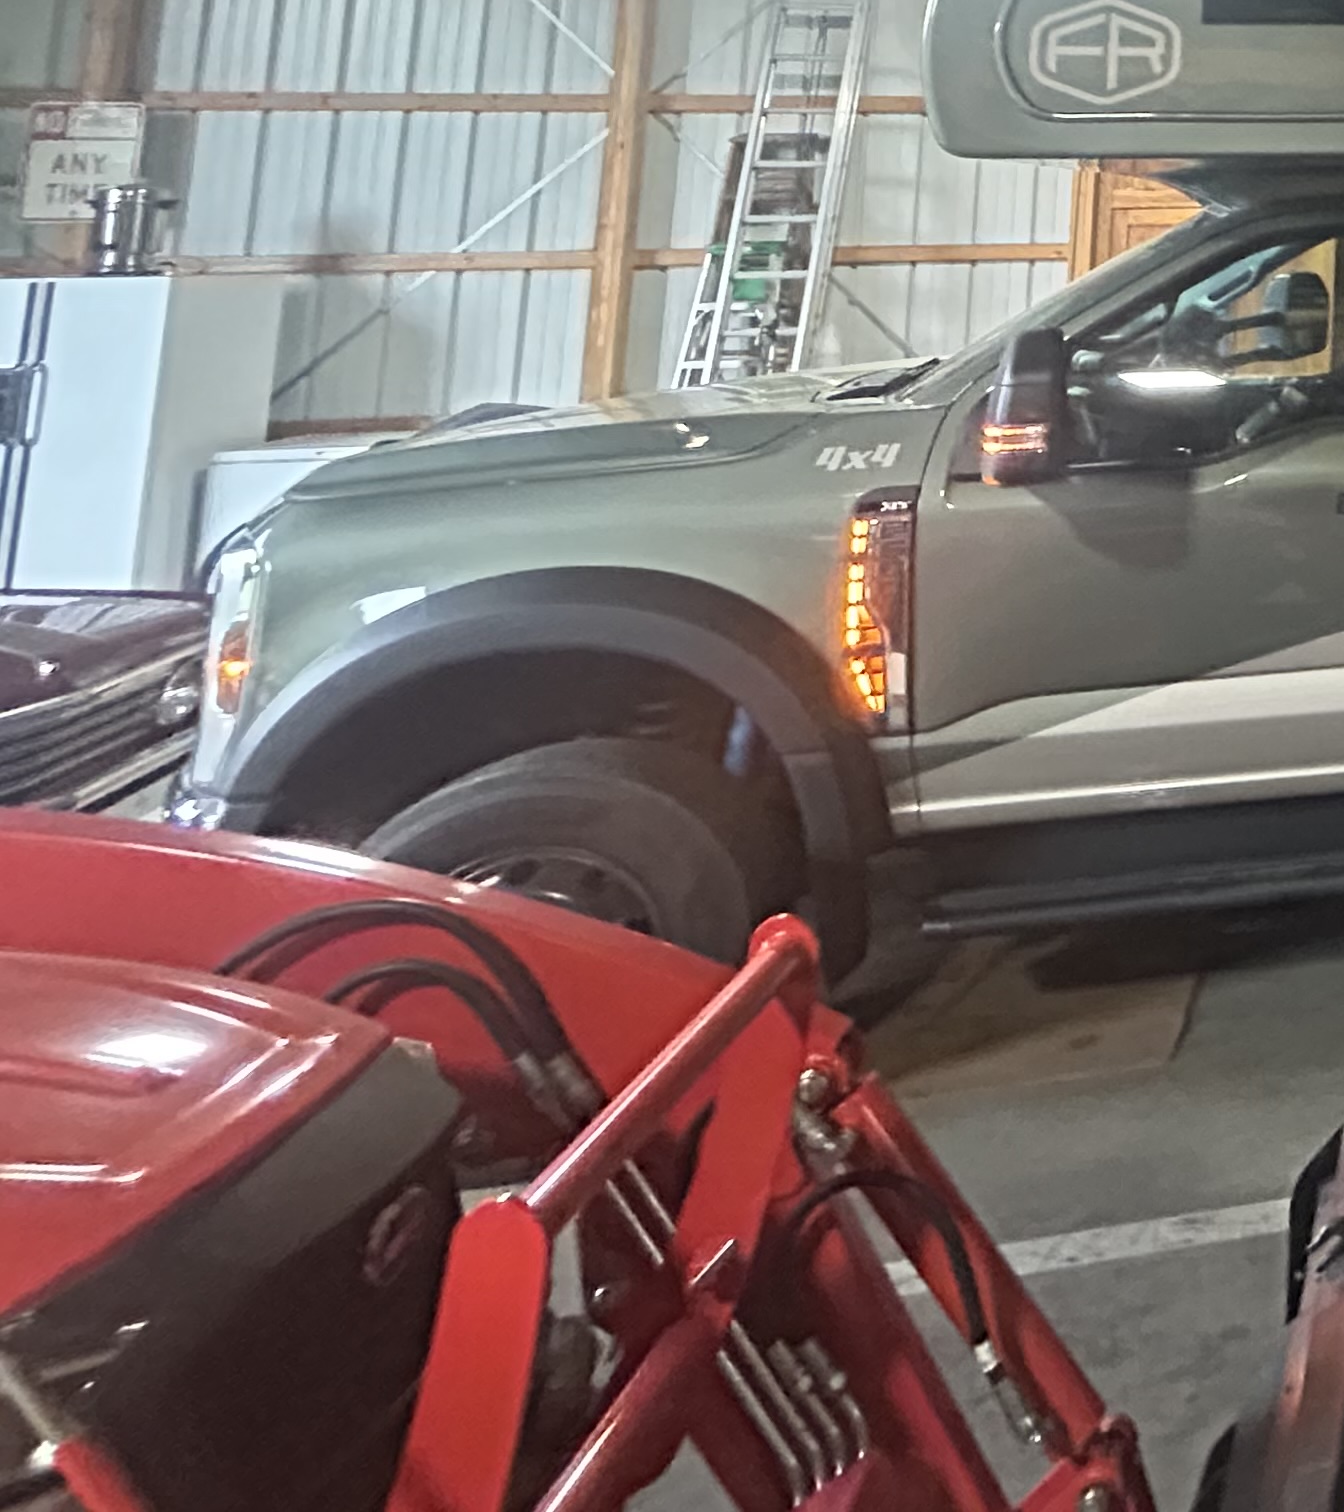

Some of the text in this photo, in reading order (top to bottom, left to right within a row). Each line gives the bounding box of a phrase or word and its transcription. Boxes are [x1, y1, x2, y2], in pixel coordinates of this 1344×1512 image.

[50, 153, 108, 175] ANY
[46, 183, 108, 205] TIM
[815, 442, 901, 471] 4x4
